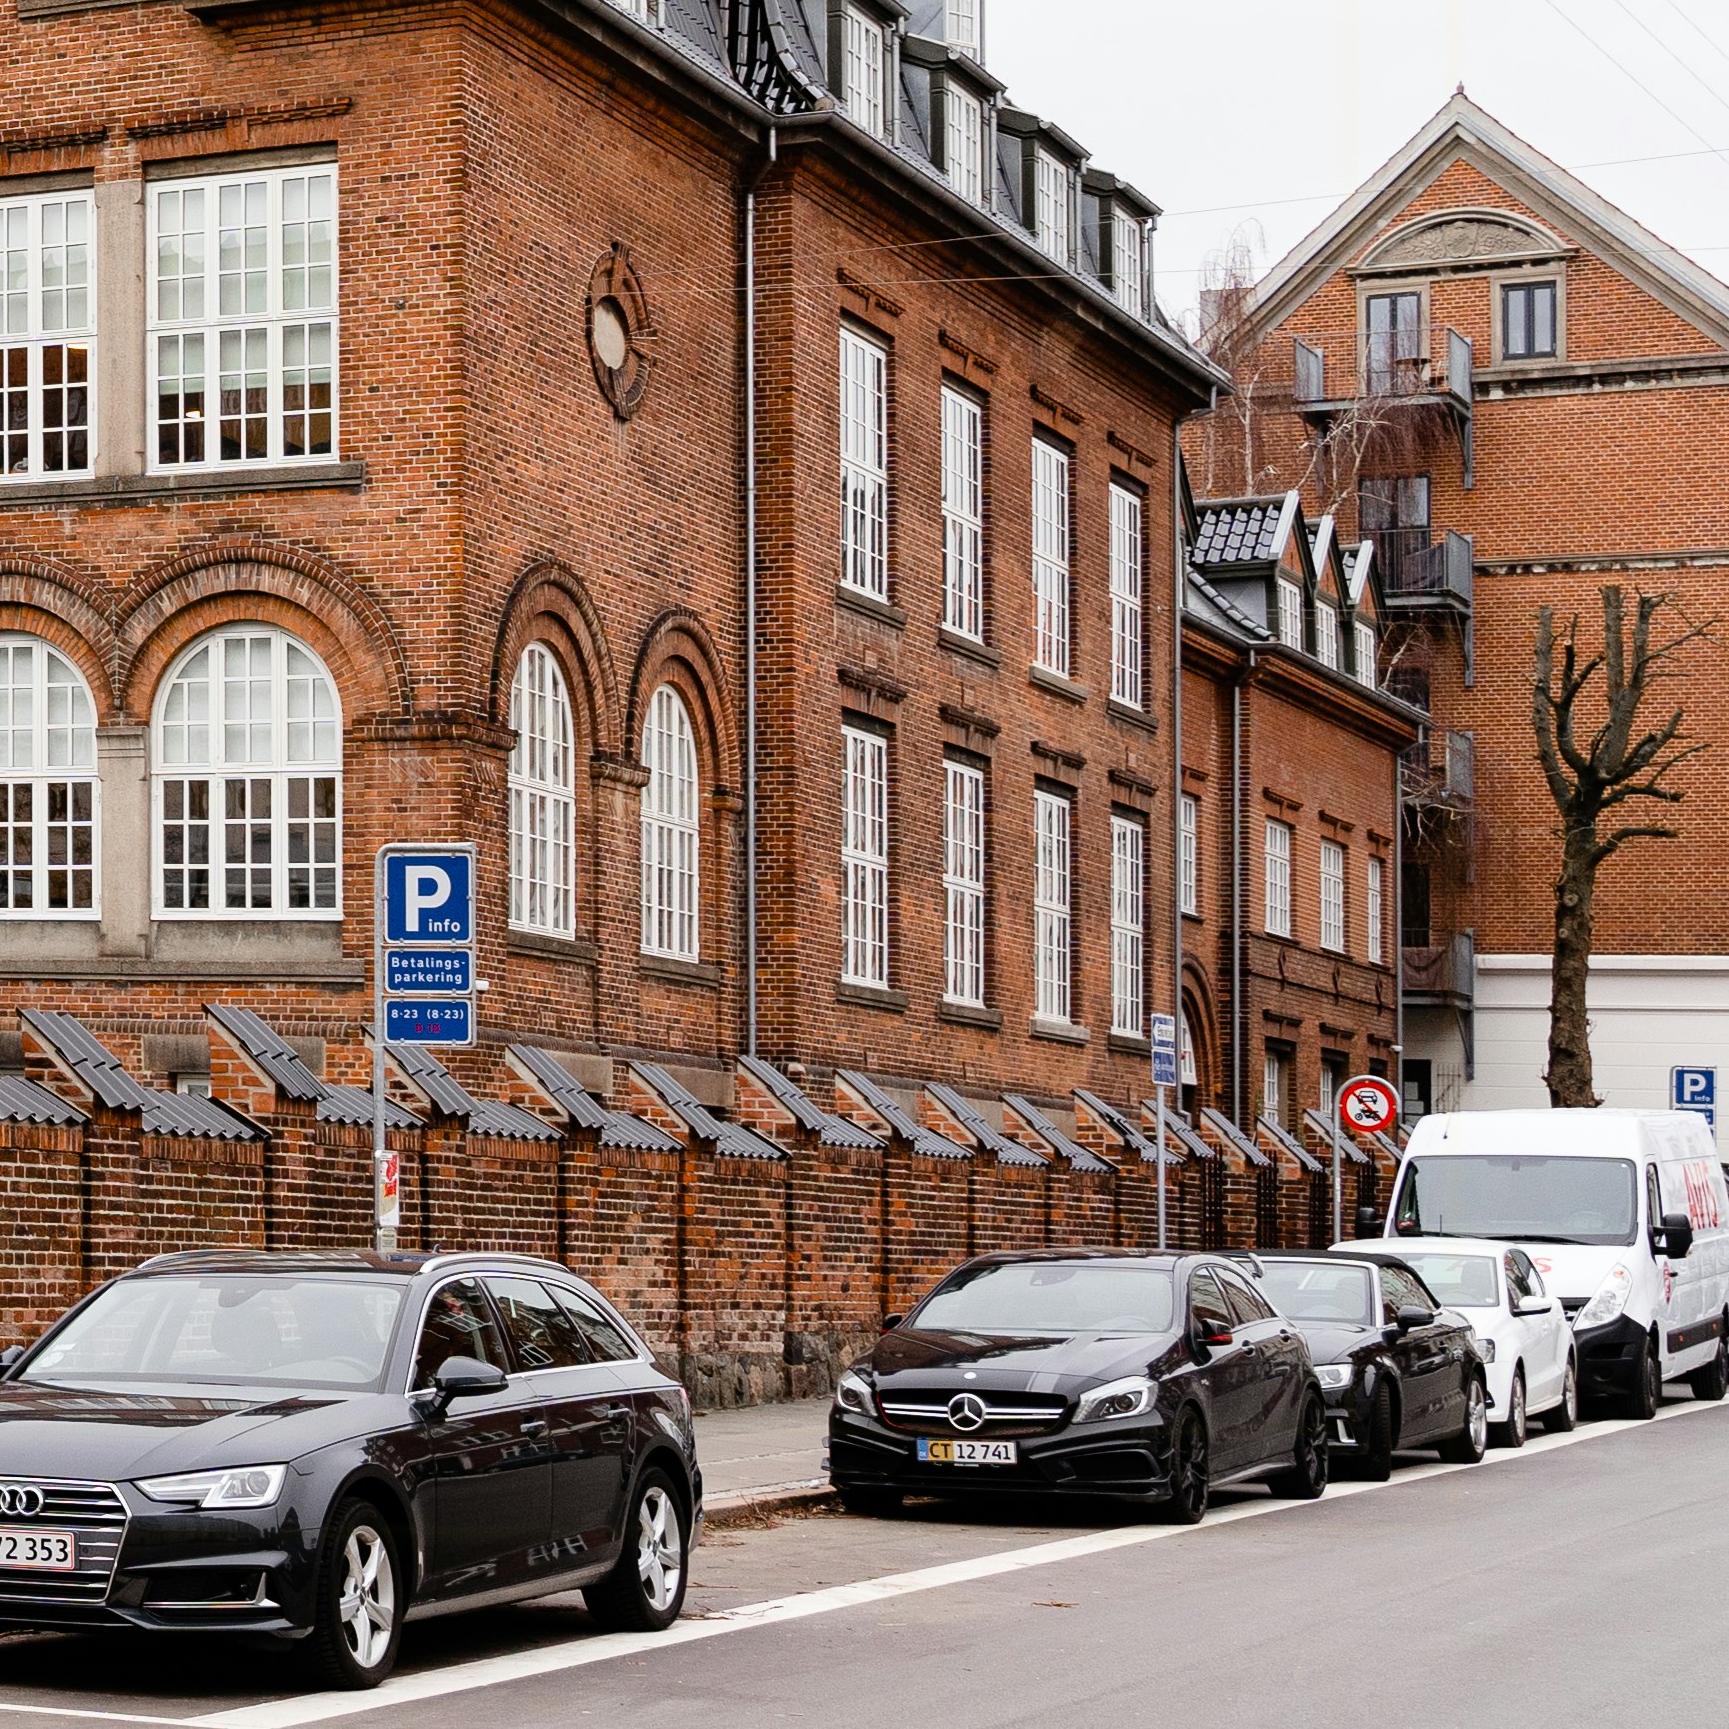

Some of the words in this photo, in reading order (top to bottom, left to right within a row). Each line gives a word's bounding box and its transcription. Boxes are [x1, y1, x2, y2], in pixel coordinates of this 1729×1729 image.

[405, 865, 452, 932] P
[428, 918, 461, 933] info
[391, 956, 466, 970] Betalings-
[394, 971, 463, 985] parkering
[1683, 1073, 1707, 1101] P
[1683, 1162, 1718, 1231] AVIS
[24, 1537, 69, 1563] 353
